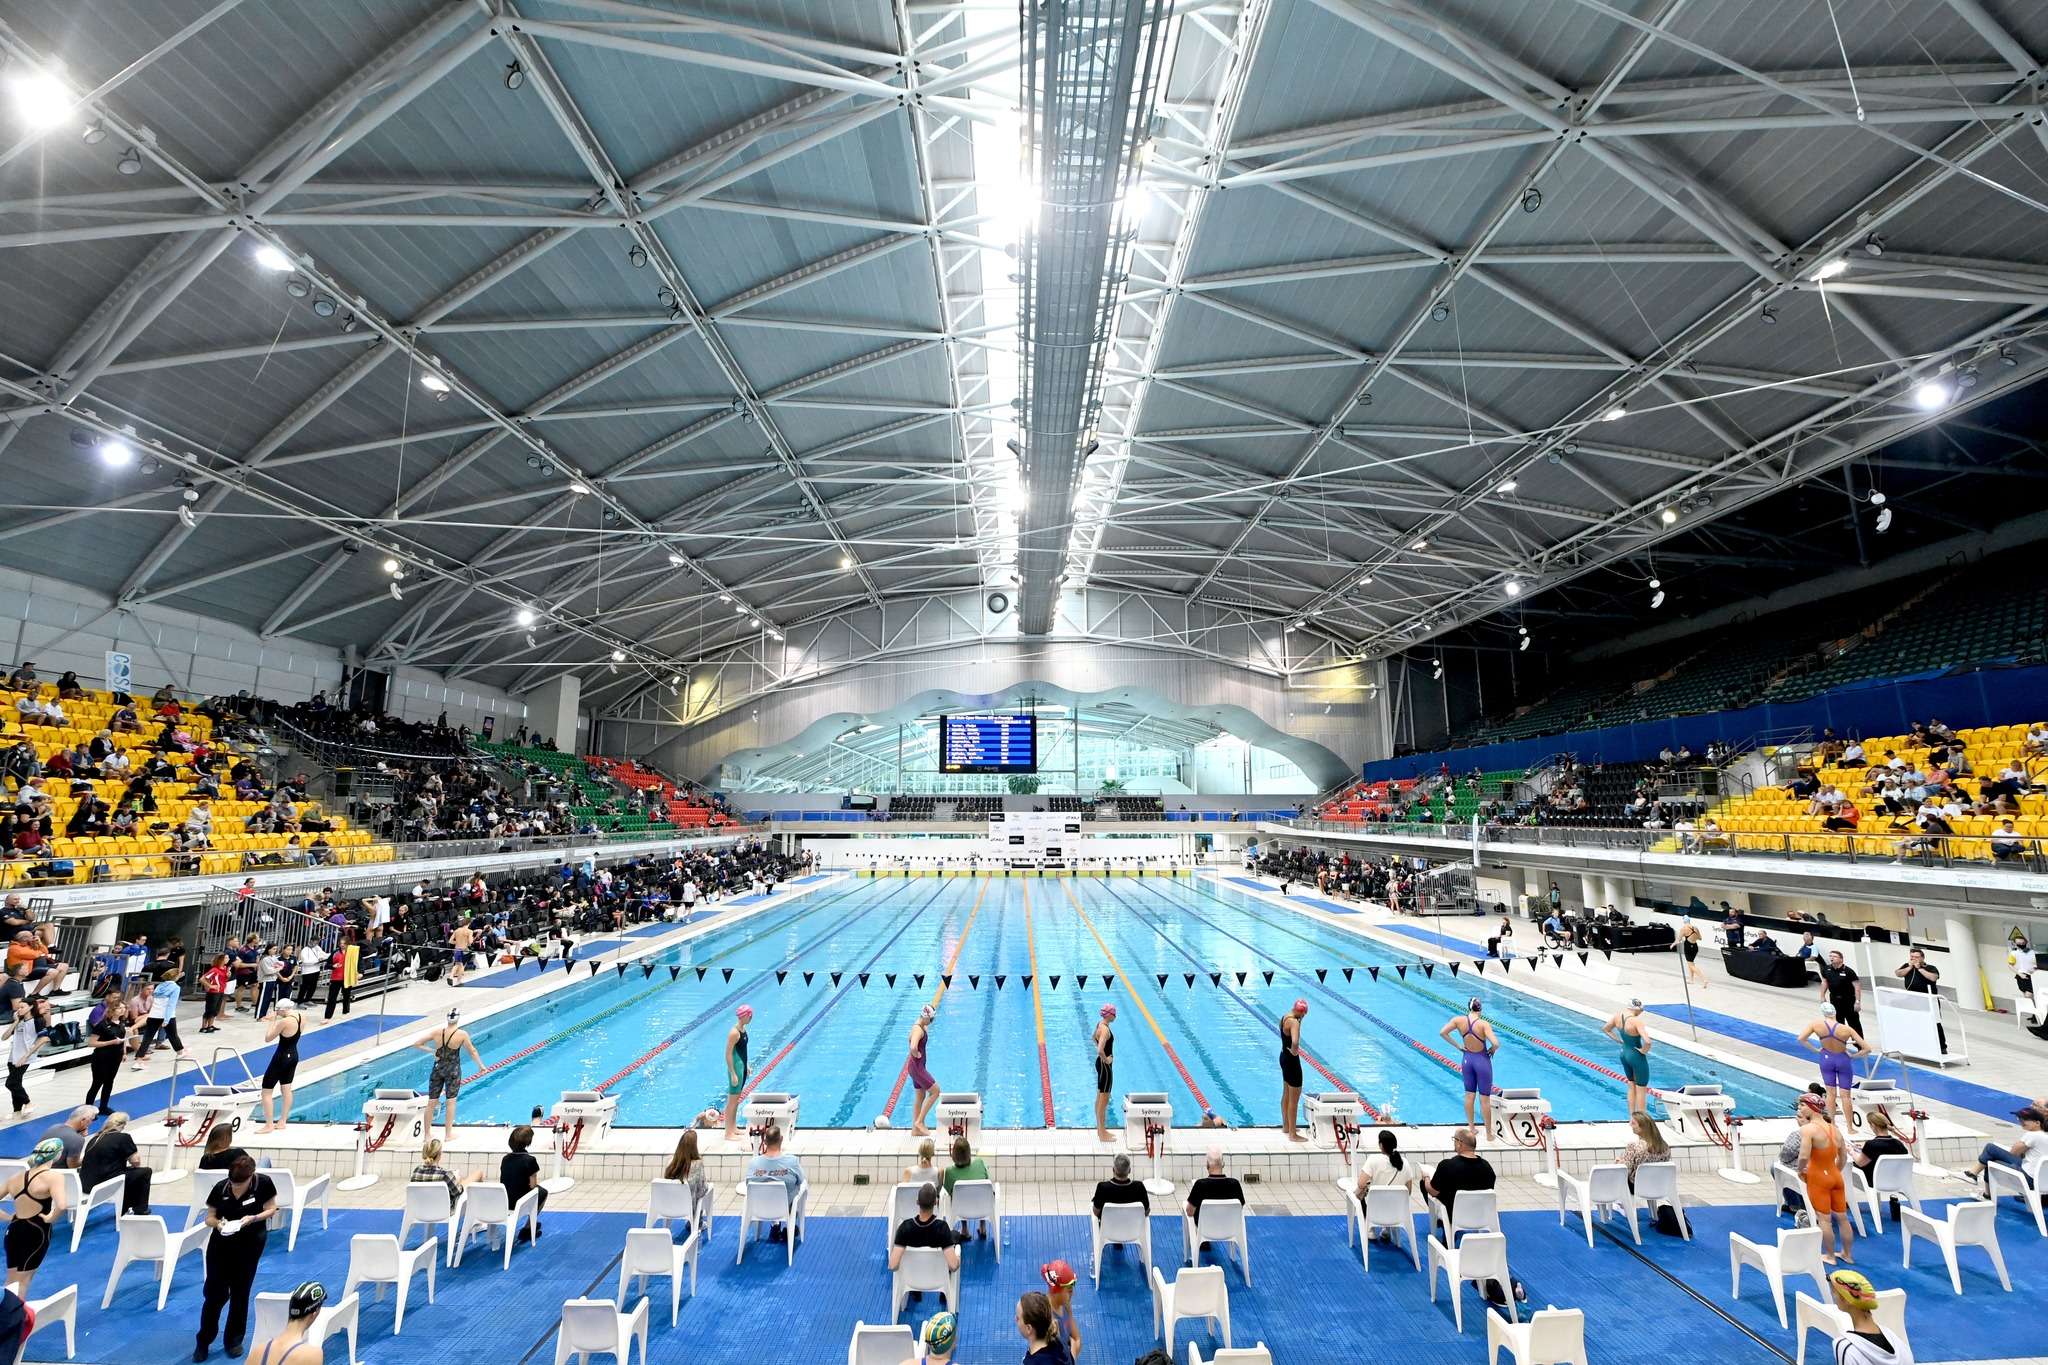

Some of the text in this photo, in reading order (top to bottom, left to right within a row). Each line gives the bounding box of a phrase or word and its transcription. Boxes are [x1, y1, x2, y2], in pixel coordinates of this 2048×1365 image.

[232, 1117, 241, 1133] 9
[413, 1120, 422, 1137] 8
[1336, 1124, 1346, 1140] 3
[1495, 1120, 1504, 1138] 2
[1521, 1120, 1535, 1138] 2
[1678, 1117, 1684, 1133] 1
